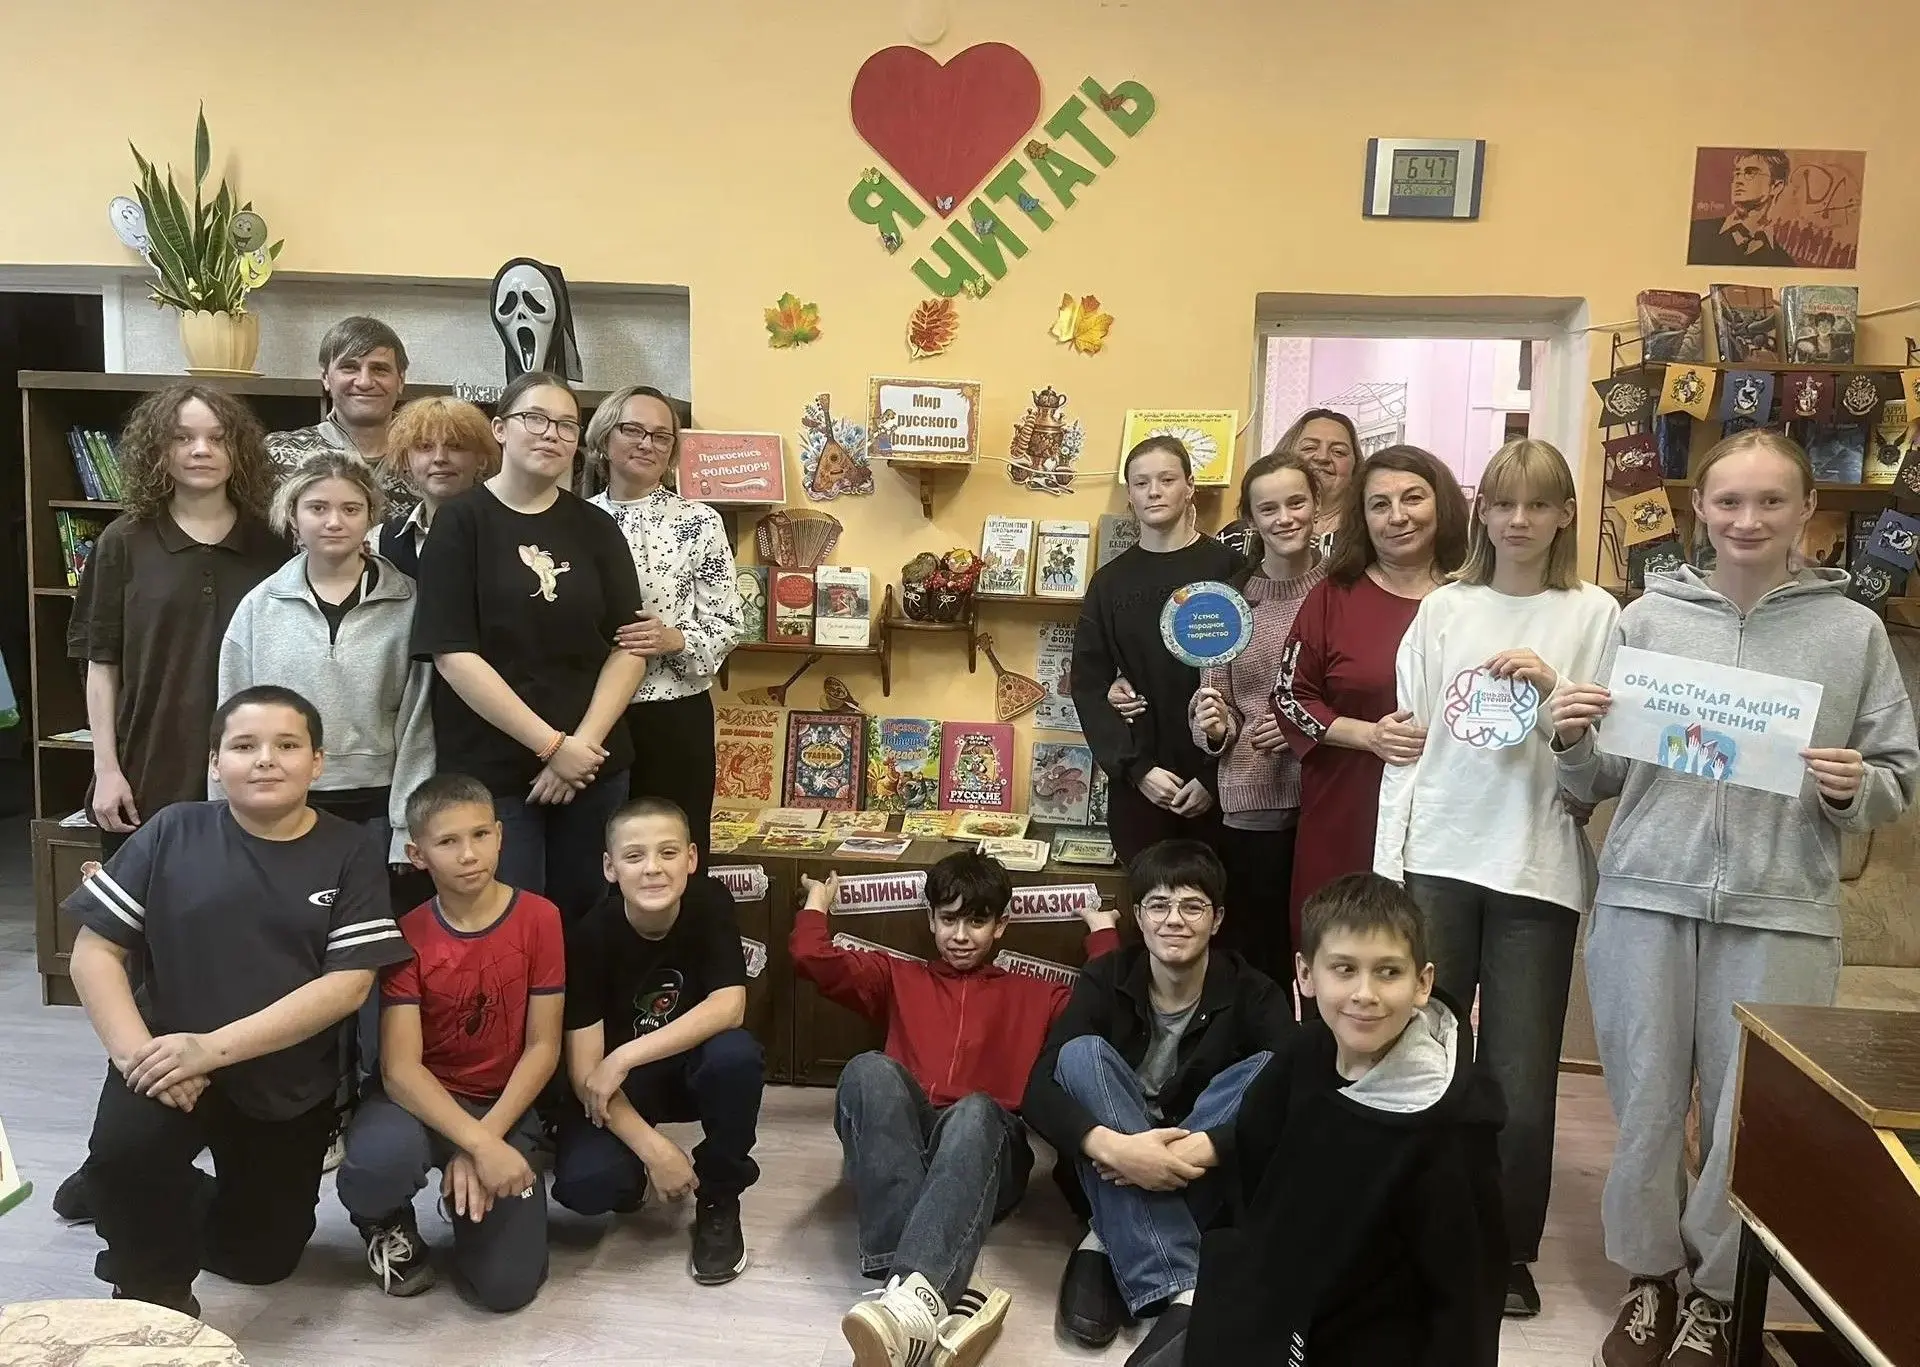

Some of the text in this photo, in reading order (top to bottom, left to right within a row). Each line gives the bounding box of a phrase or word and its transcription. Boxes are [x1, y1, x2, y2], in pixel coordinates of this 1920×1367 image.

[910, 76, 1155, 300] ЧИТАТЬ
[849, 167, 926, 255] Я
[912, 394, 941, 409] Мир
[897, 415, 958, 429] русского
[698, 450, 762, 463] Прикоснись
[700, 461, 770, 478] ФОЛЬКЛОРУ!
[1624, 673, 1801, 720] ОБЛАСТНАЯ АКЦИЯ
[1643, 696, 1767, 733] ДЕНЬ ЧТЕНИЯ
[950, 790, 1001, 801] РУССКИЕ
[840, 880, 918, 905] БЫЛИНЫ
[1010, 892, 1086, 914] СКАЗКИ
